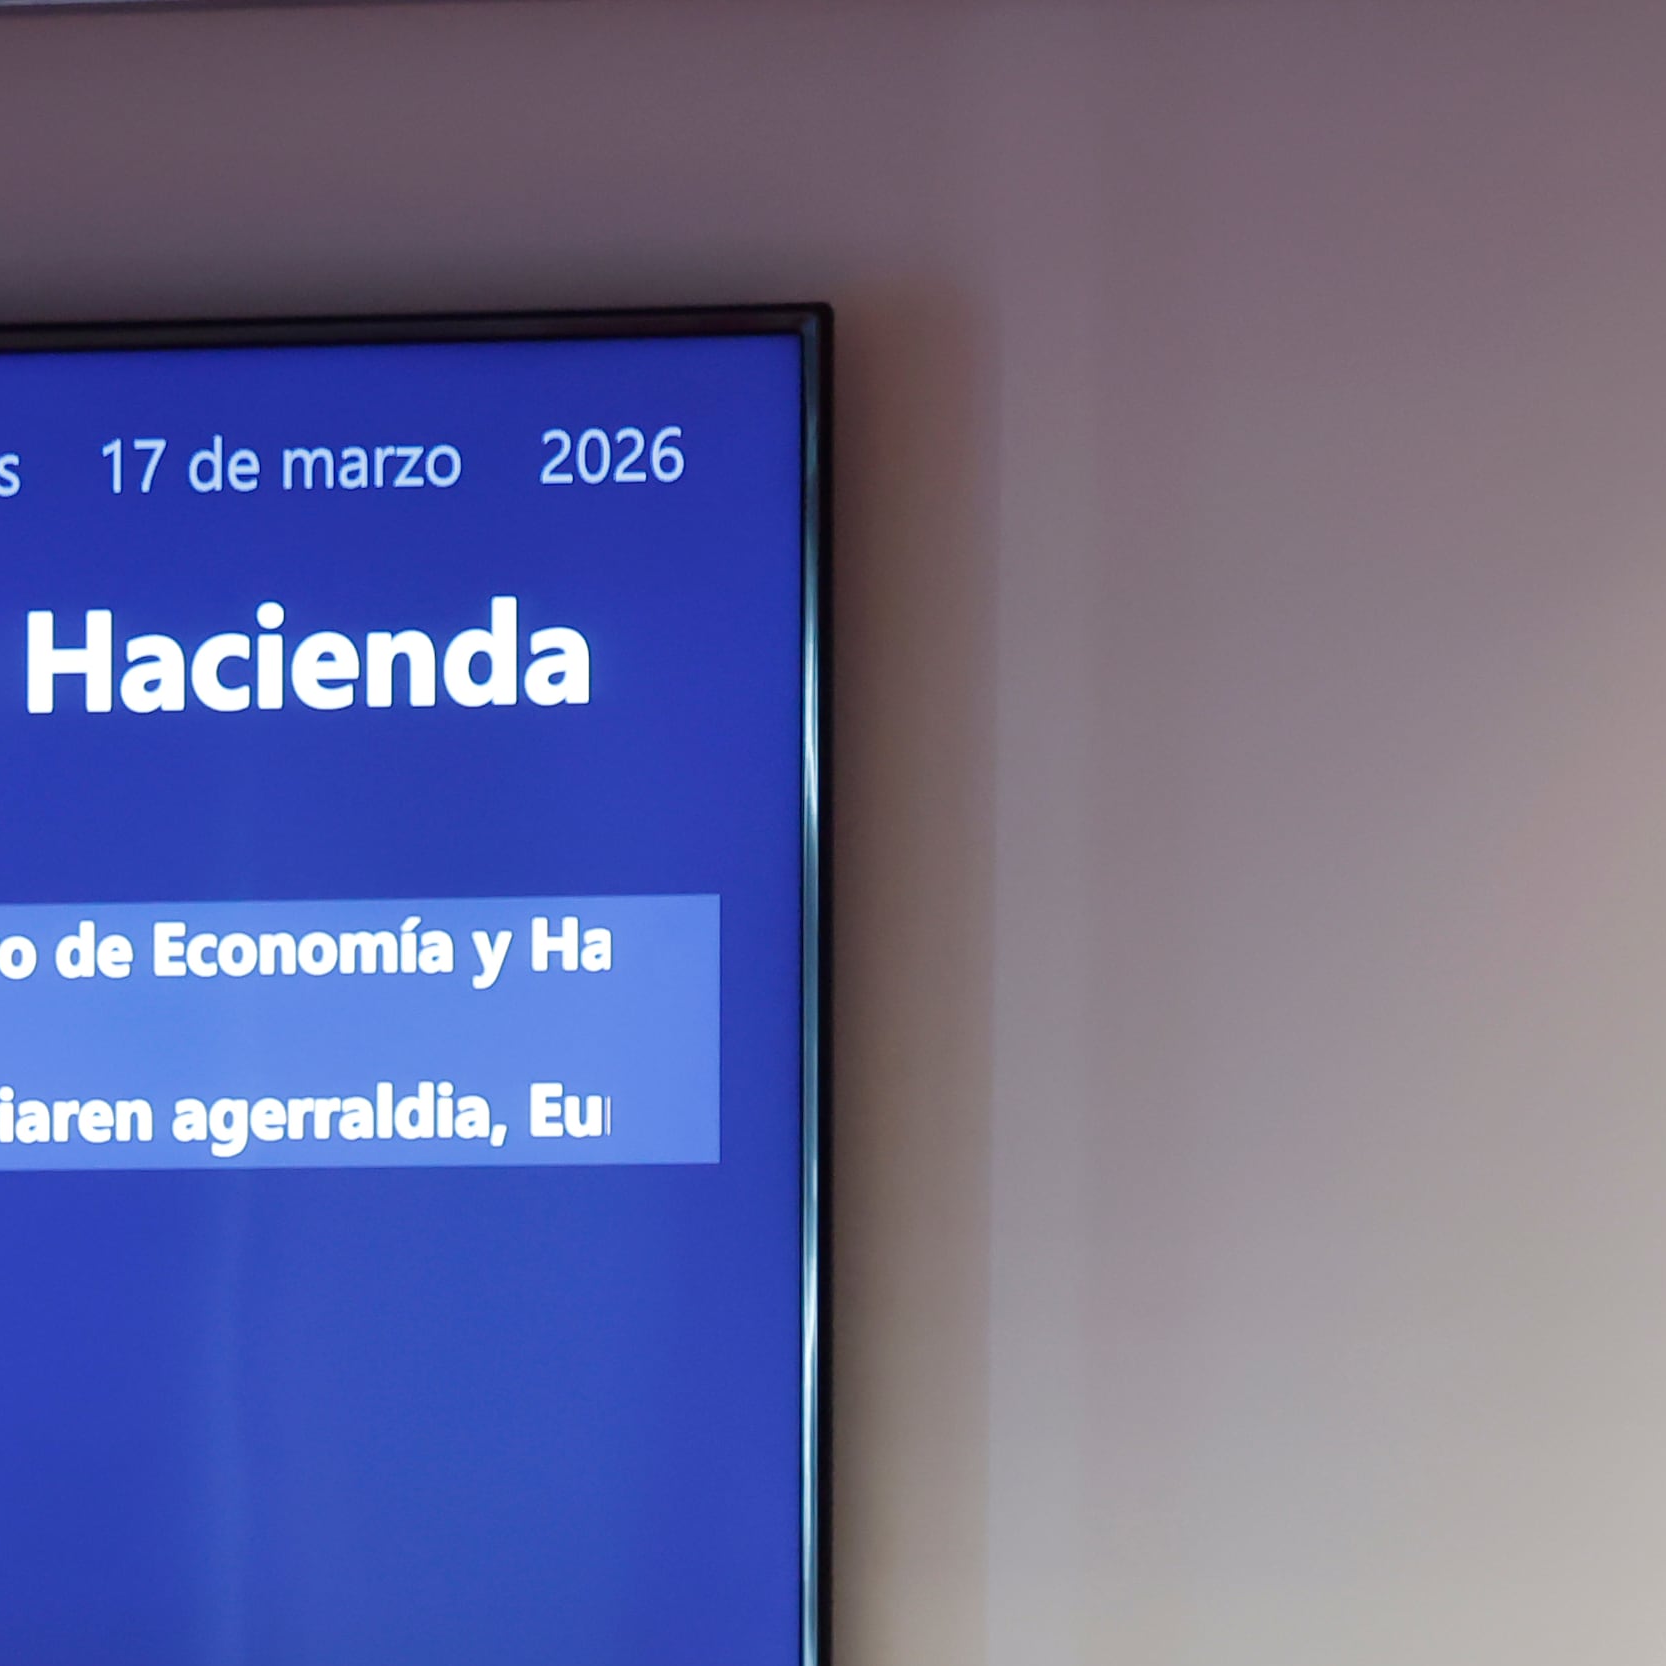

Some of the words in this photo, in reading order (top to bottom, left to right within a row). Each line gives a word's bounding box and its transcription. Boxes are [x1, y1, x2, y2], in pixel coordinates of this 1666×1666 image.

[103, 439, 166, 493] 17
[189, 435, 260, 492] de
[283, 445, 461, 490] marzo
[541, 427, 684, 484] 2026
[27, 596, 590, 714] Hacienda
[55, 920, 134, 979] de
[153, 916, 454, 977] Economía
[472, 930, 512, 989] y
[531, 916, 612, 972] Ha
[172, 1081, 507, 1158] agerraldia,
[530, 1082, 611, 1138] Eu
